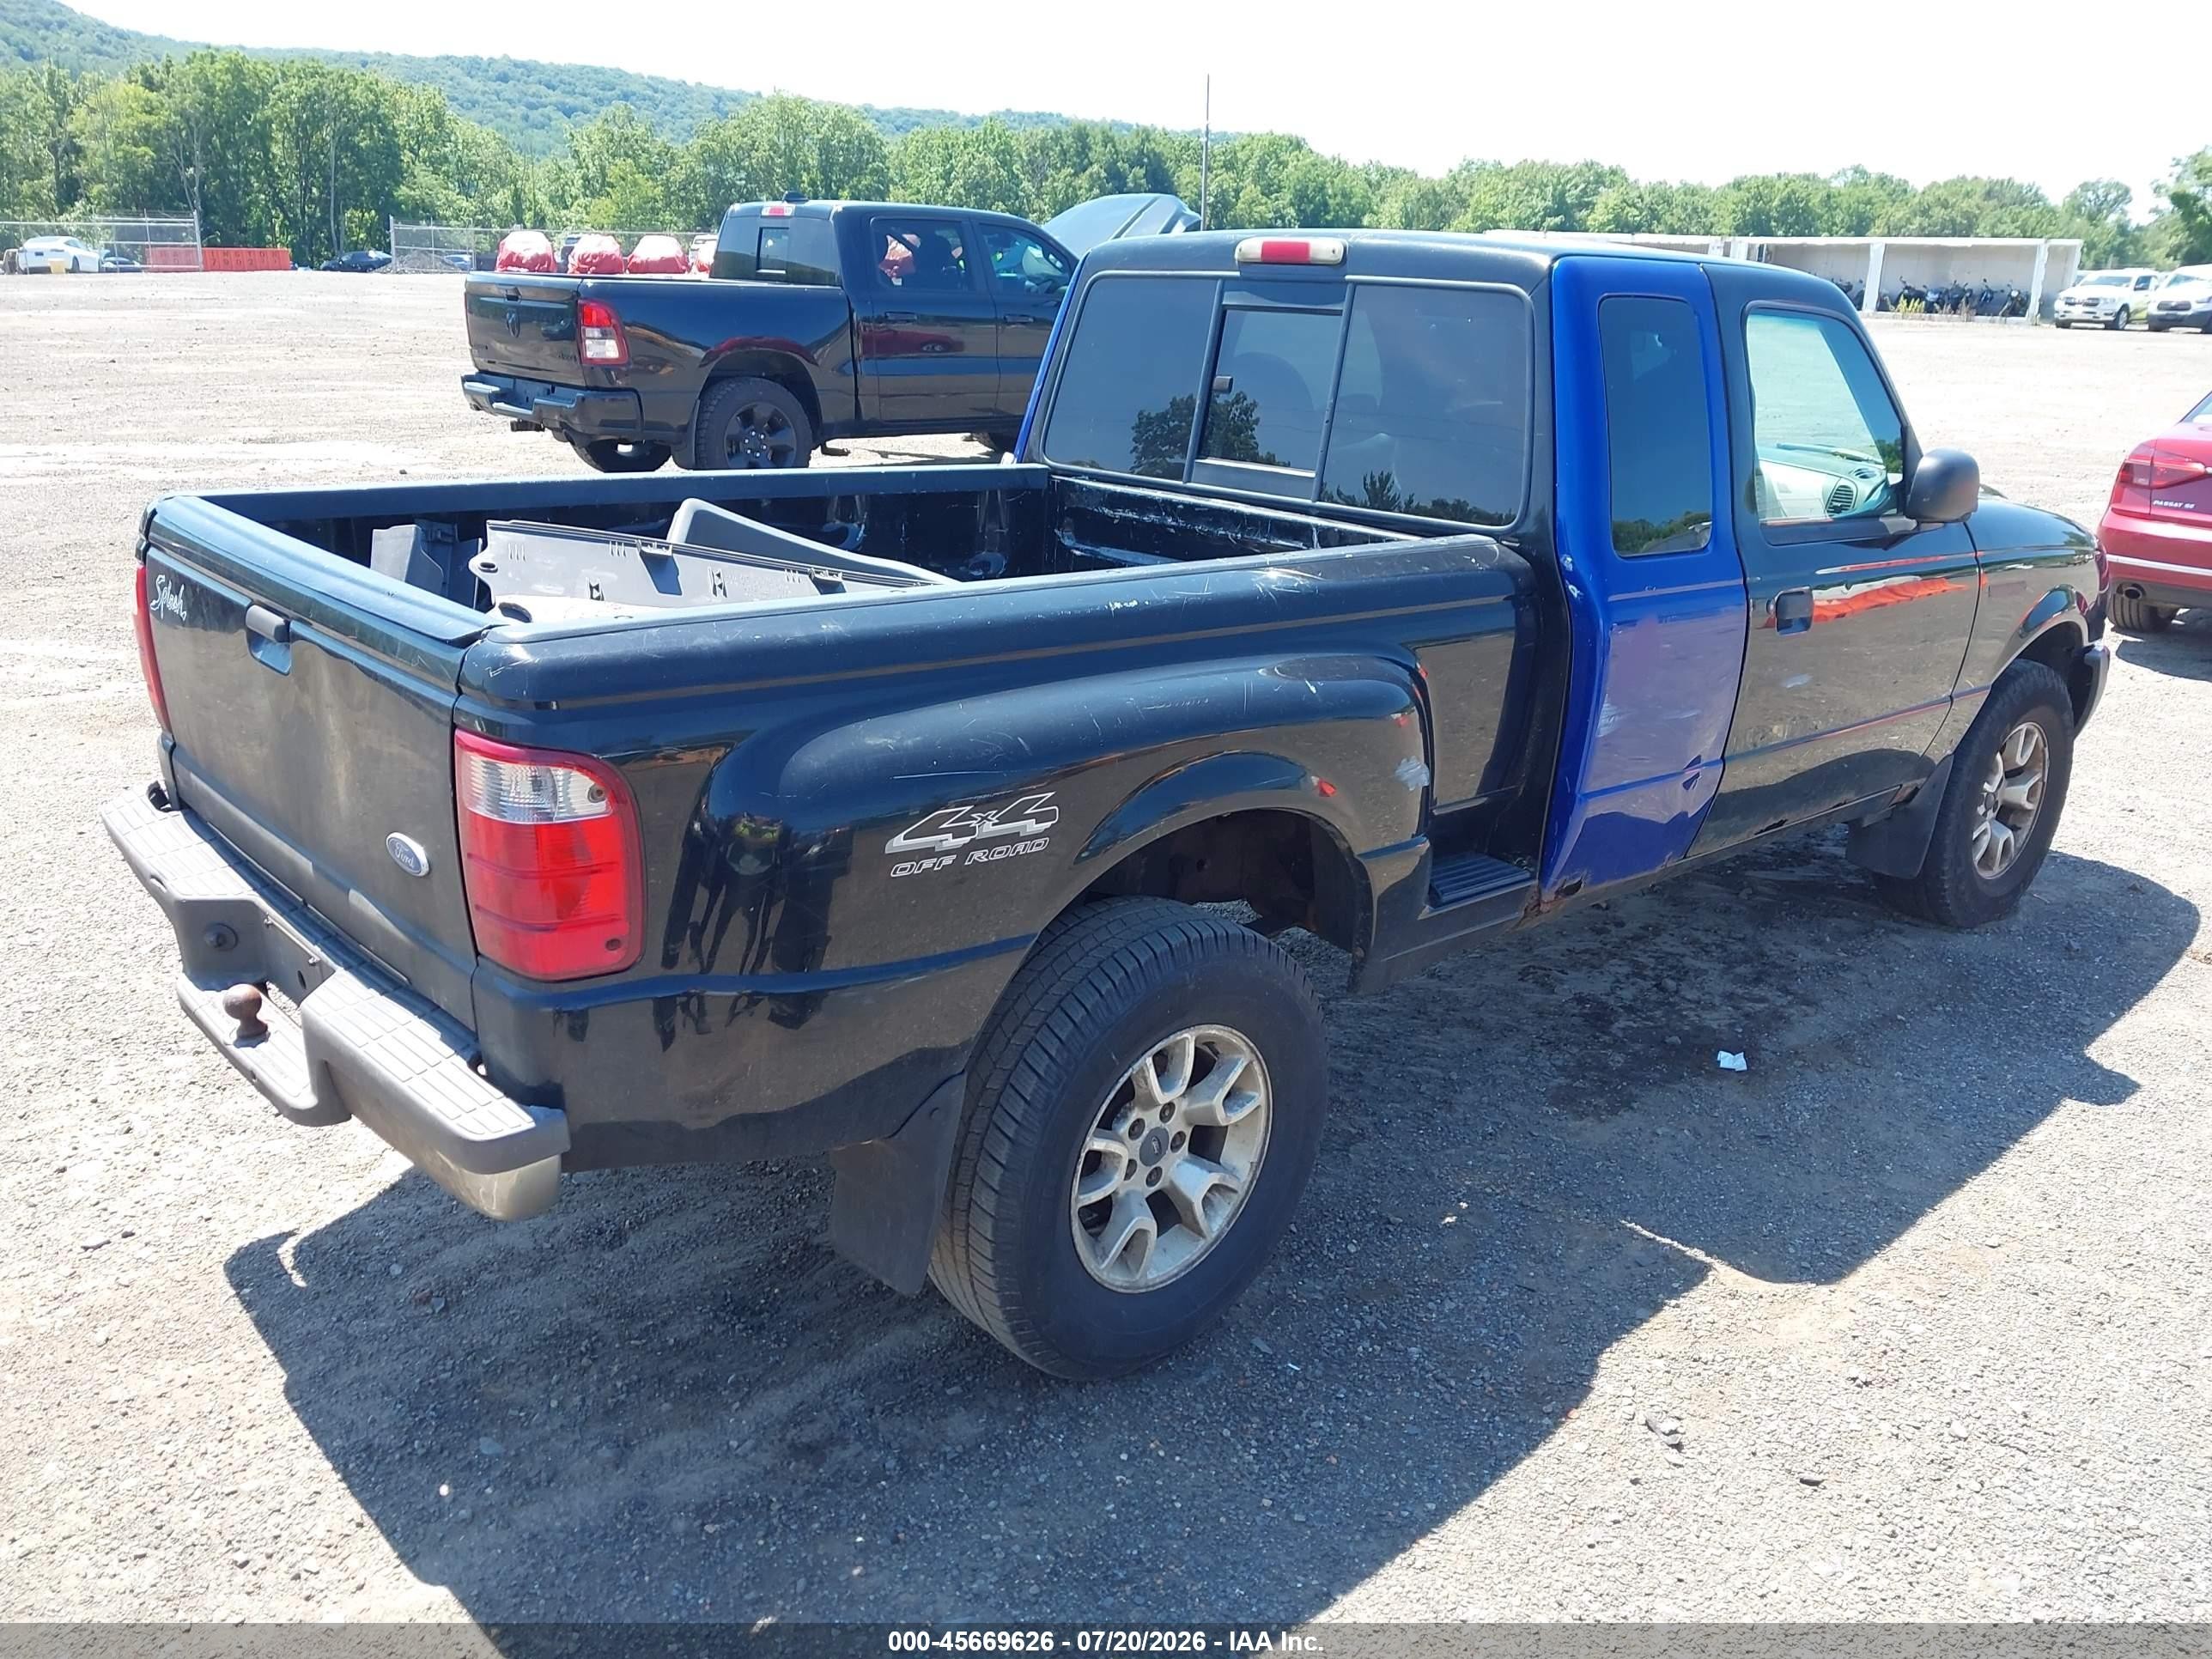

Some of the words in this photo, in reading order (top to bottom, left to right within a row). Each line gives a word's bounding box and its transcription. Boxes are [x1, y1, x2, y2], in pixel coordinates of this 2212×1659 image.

[2153, 500, 2183, 508] PASSAT
[149, 574, 187, 622] Splash
[395, 842, 415, 869] Ford
[890, 854, 957, 878] OFF
[964, 837, 1050, 866] ROAD
